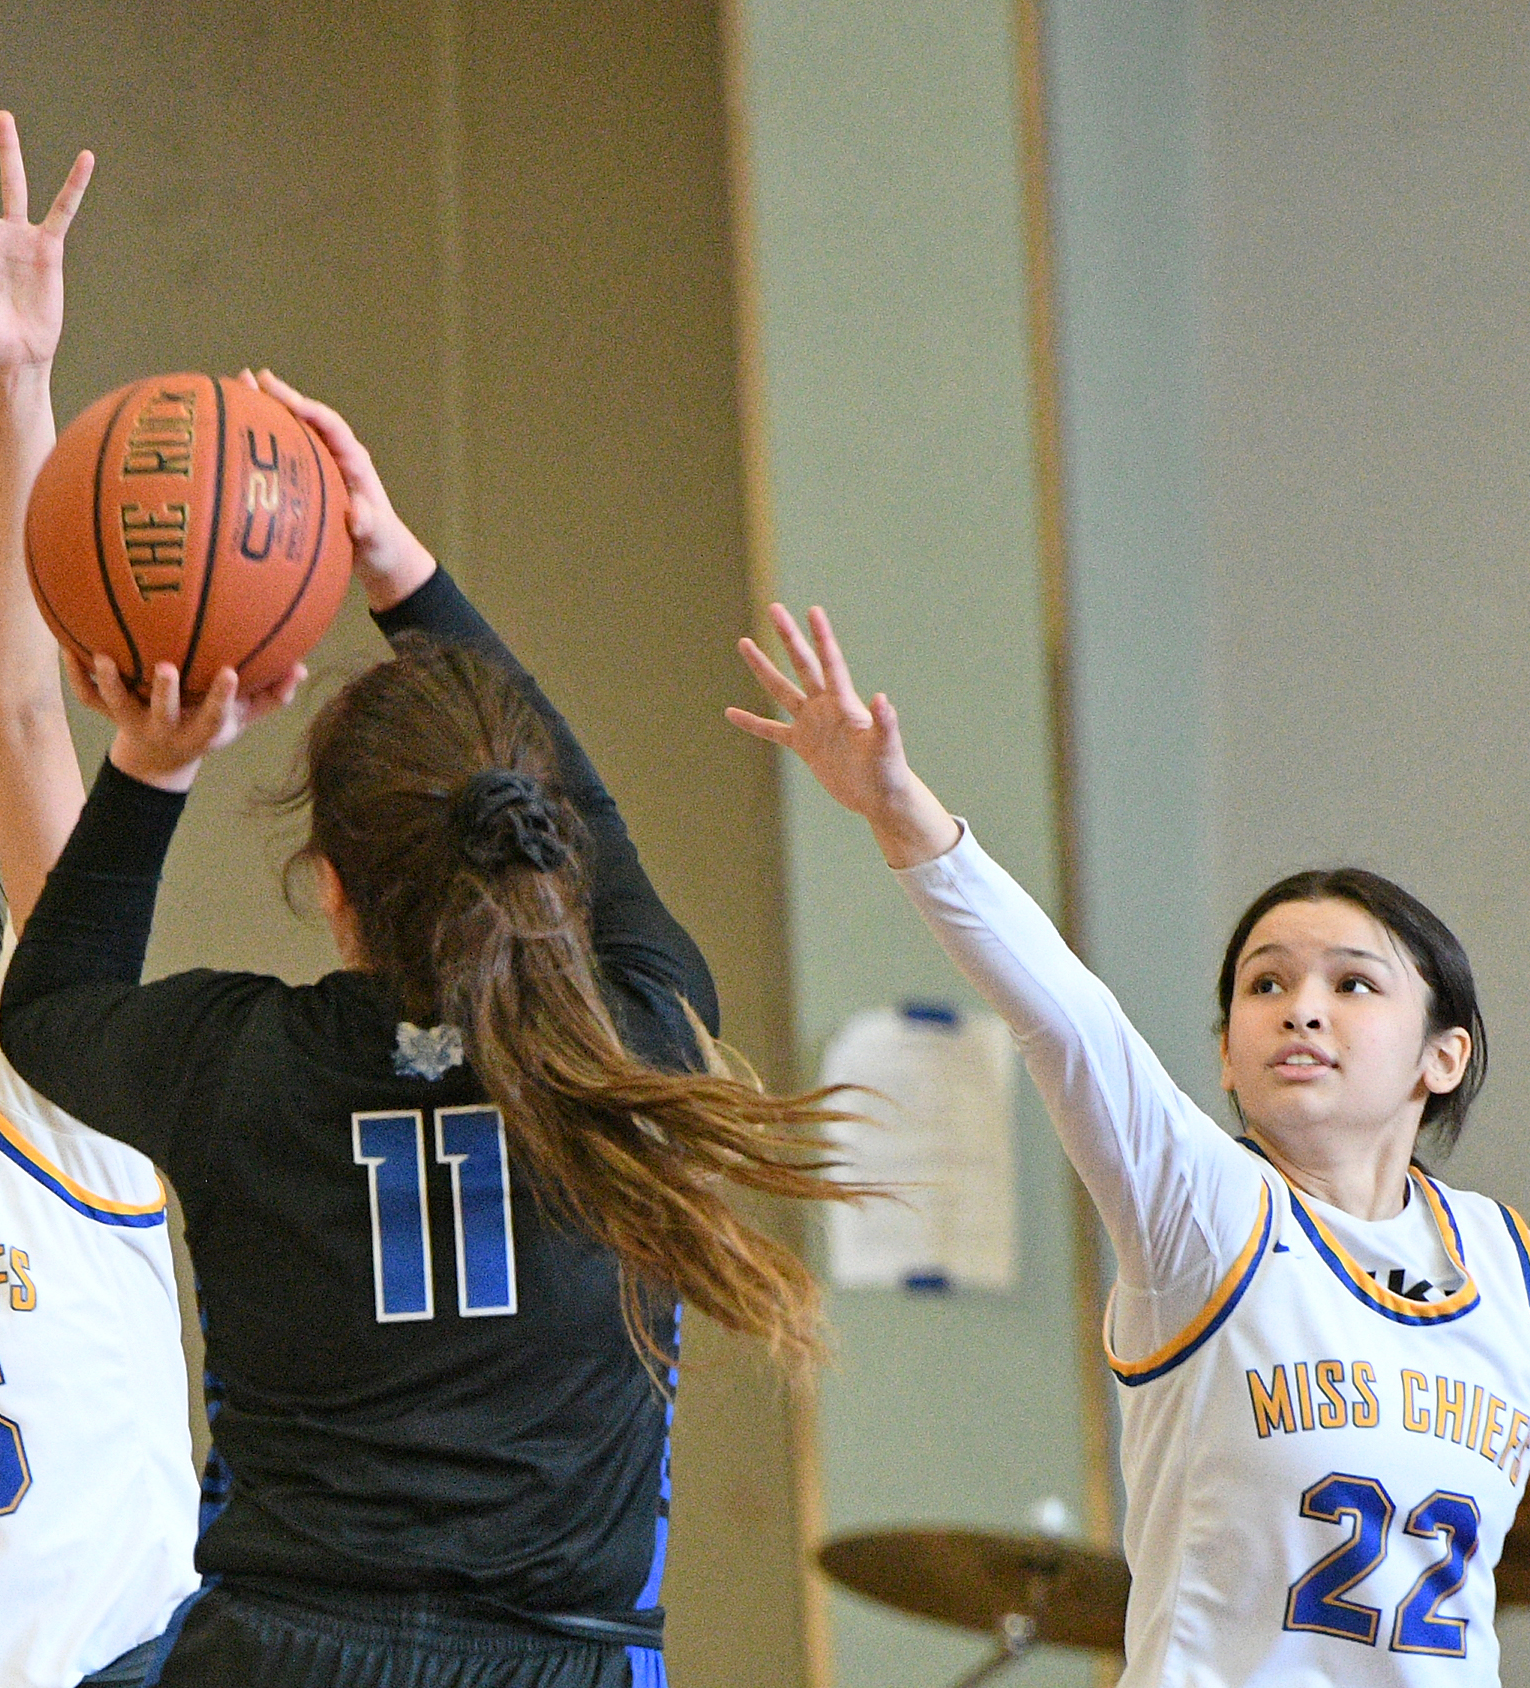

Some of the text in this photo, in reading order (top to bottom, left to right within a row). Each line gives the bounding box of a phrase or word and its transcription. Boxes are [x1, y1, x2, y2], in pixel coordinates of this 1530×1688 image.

[121, 502, 190, 602] THE
[239, 426, 280, 562] C2C
[351, 1104, 518, 1324] 11
[1246, 1359, 1380, 1439] MISS
[1282, 1471, 1481, 1658] 22
